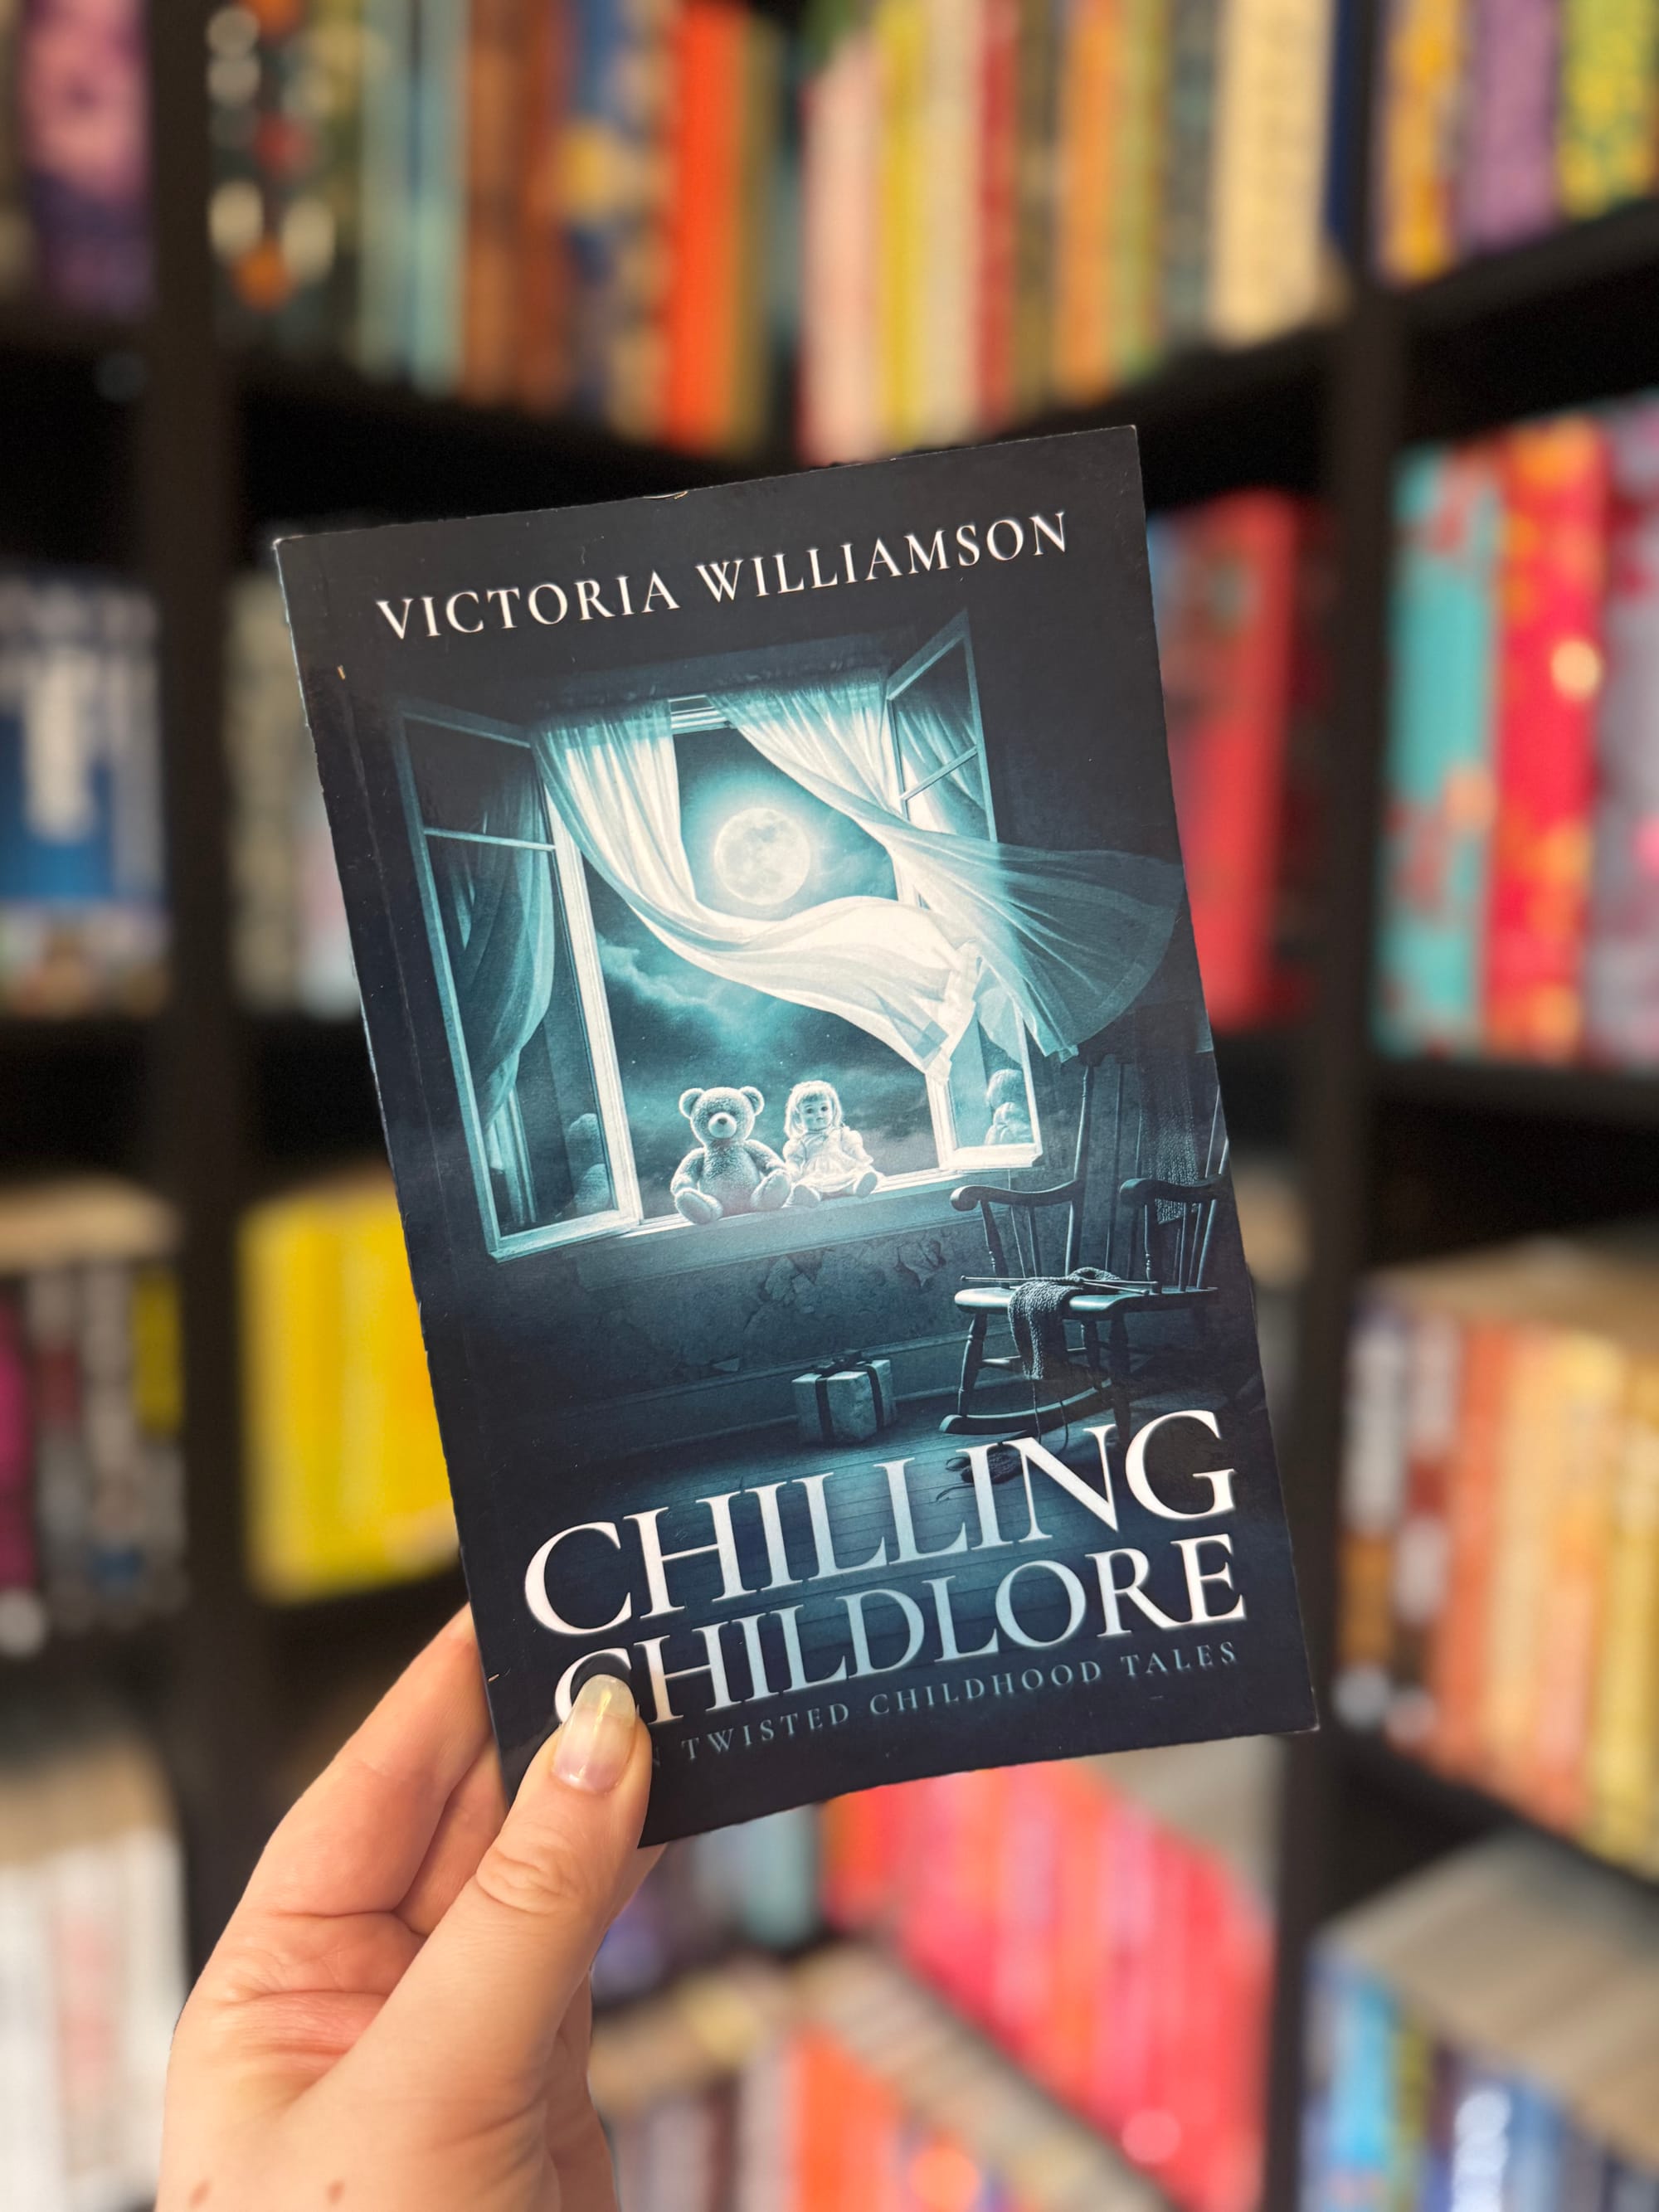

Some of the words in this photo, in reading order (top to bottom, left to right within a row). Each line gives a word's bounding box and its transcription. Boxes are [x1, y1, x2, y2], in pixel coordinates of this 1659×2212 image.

[377, 571, 681, 640] VICTORIA
[697, 511, 1070, 604] WILLIAMSON
[523, 1409, 1237, 1637] CHILLING
[681, 1703, 849, 1760] TWISTED
[869, 1660, 1102, 1716] CHILDHOOD
[1120, 1641, 1238, 1677] TALES
